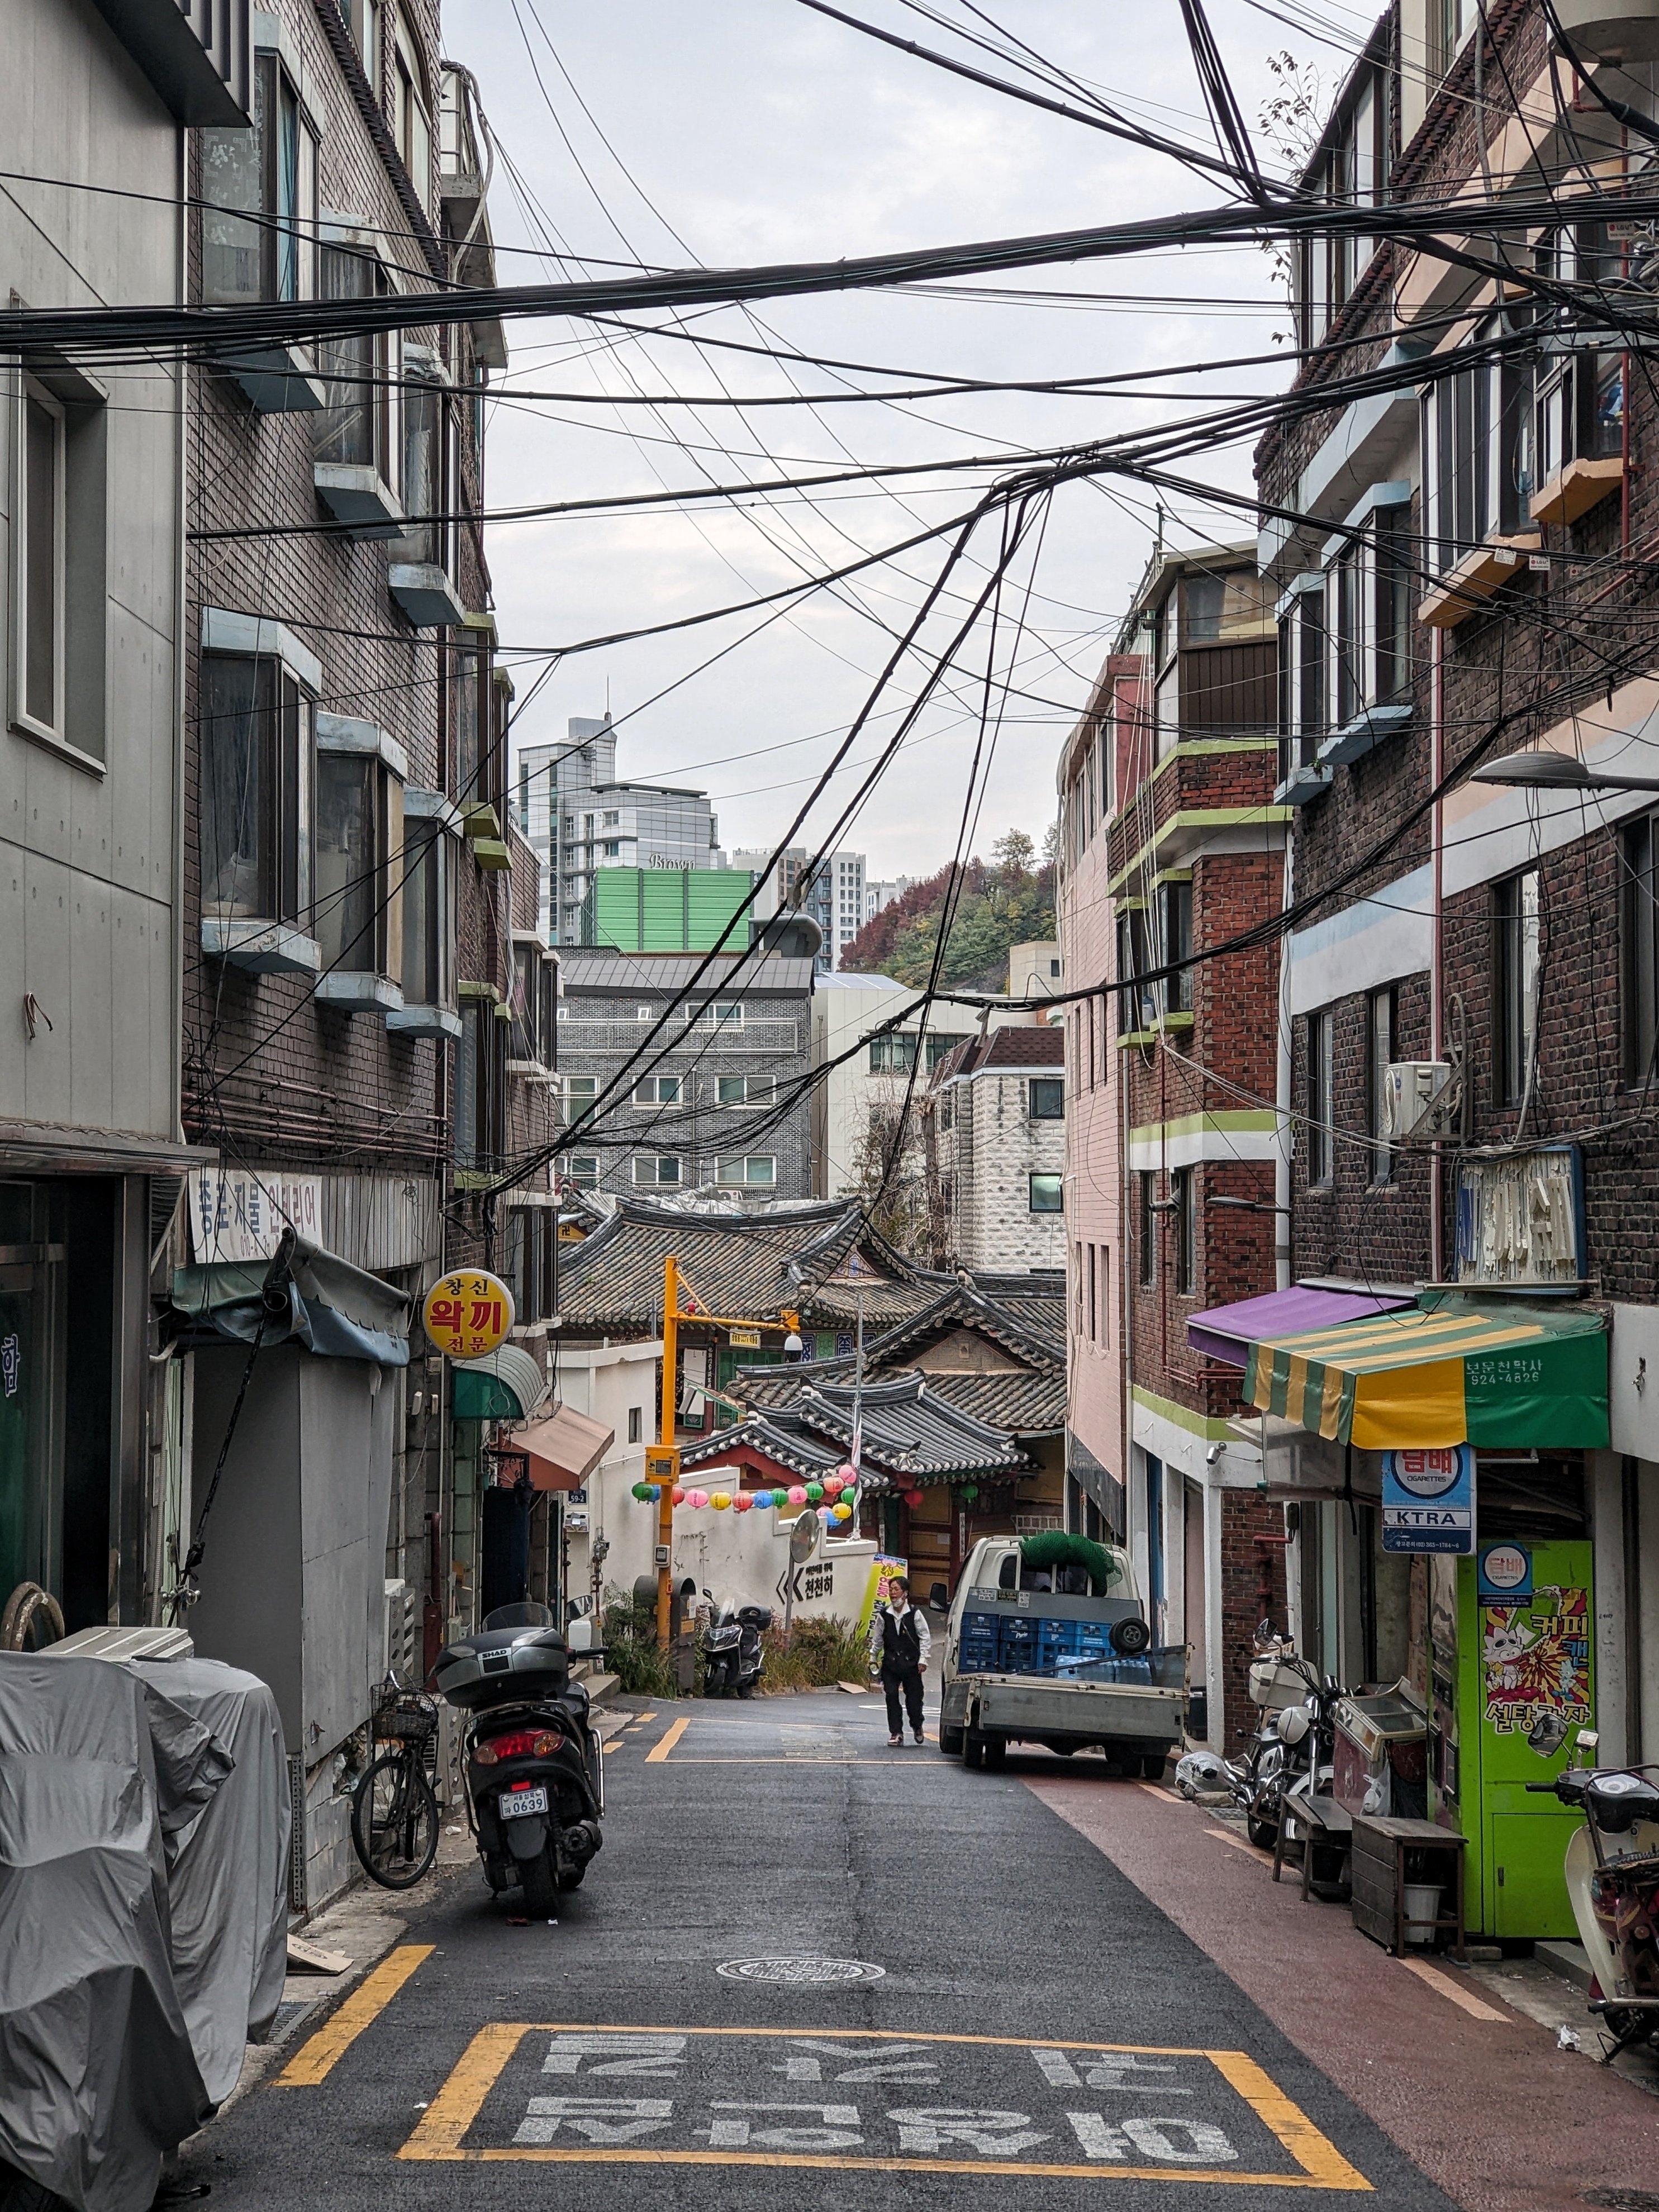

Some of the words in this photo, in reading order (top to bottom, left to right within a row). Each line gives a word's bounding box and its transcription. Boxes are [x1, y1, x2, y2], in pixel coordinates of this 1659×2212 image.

[650, 853, 695, 869] Brown
[269, 1184, 316, 1233] 인테리어
[443, 1278, 488, 1296] 창신
[430, 1300, 501, 1334] 왁끼
[446, 1336, 488, 1352] 전문
[1466, 1359, 1543, 1374] 보문천막사
[1402, 1449, 1452, 1474] 담배
[1397, 1511, 1457, 1525] KTRA
[805, 1574, 833, 1600] 천천히
[1530, 1615, 1588, 1635] 커피
[482, 1650, 507, 1658] SHAD
[1562, 1640, 1588, 1667] 캔
[514, 1799, 543, 1813] 0639
